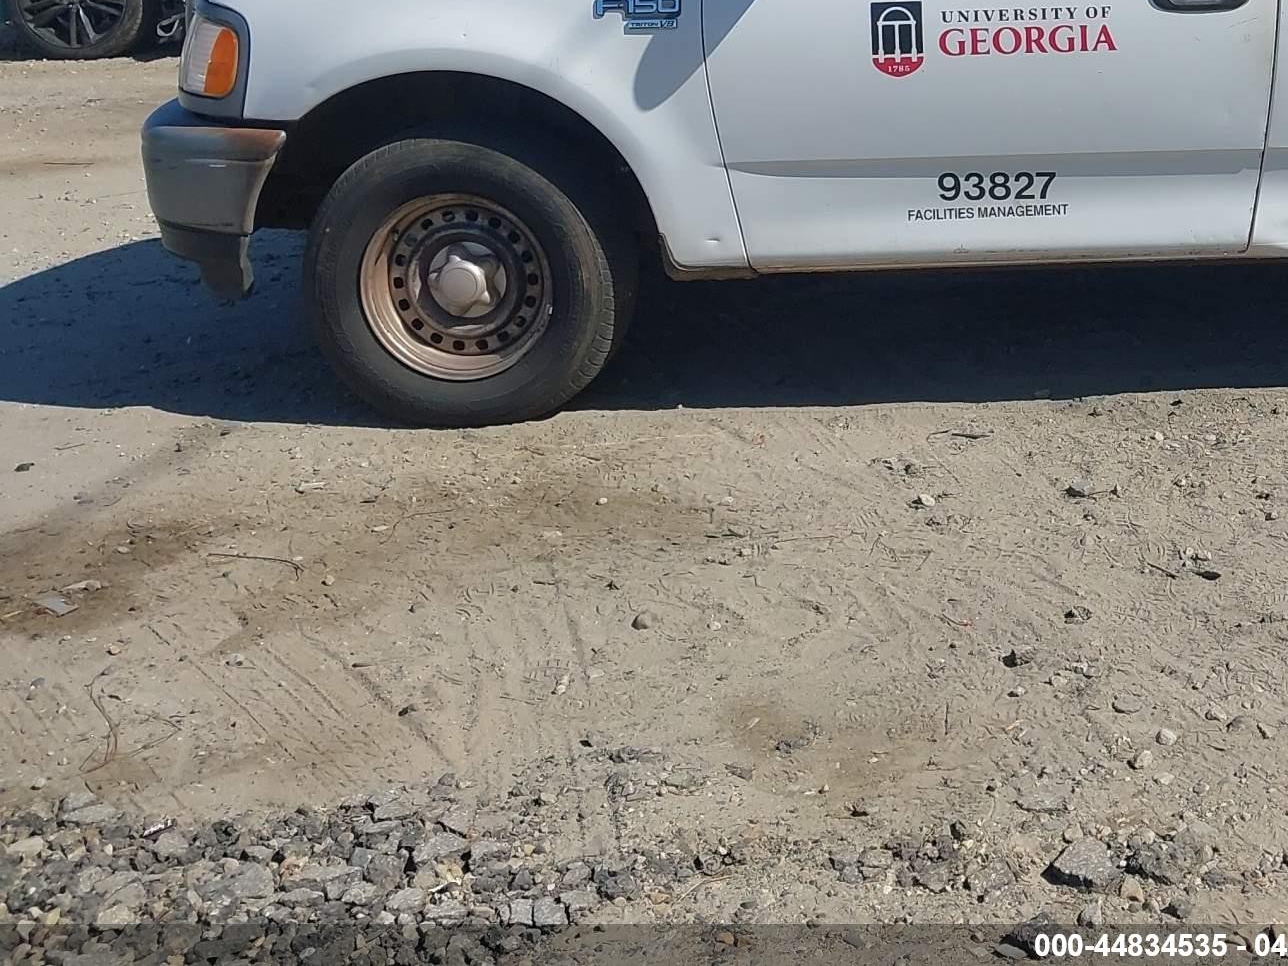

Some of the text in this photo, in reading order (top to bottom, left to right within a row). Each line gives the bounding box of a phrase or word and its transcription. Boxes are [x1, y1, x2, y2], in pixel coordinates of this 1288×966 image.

[941, 5, 1112, 23] UNIVERSITY OF
[660, 19, 676, 28] V8
[938, 24, 1118, 56] GEORGIA
[887, 65, 911, 73] 1785
[937, 171, 1057, 202] 93827
[908, 203, 1069, 221] FACILITIES MANAGEMENT
